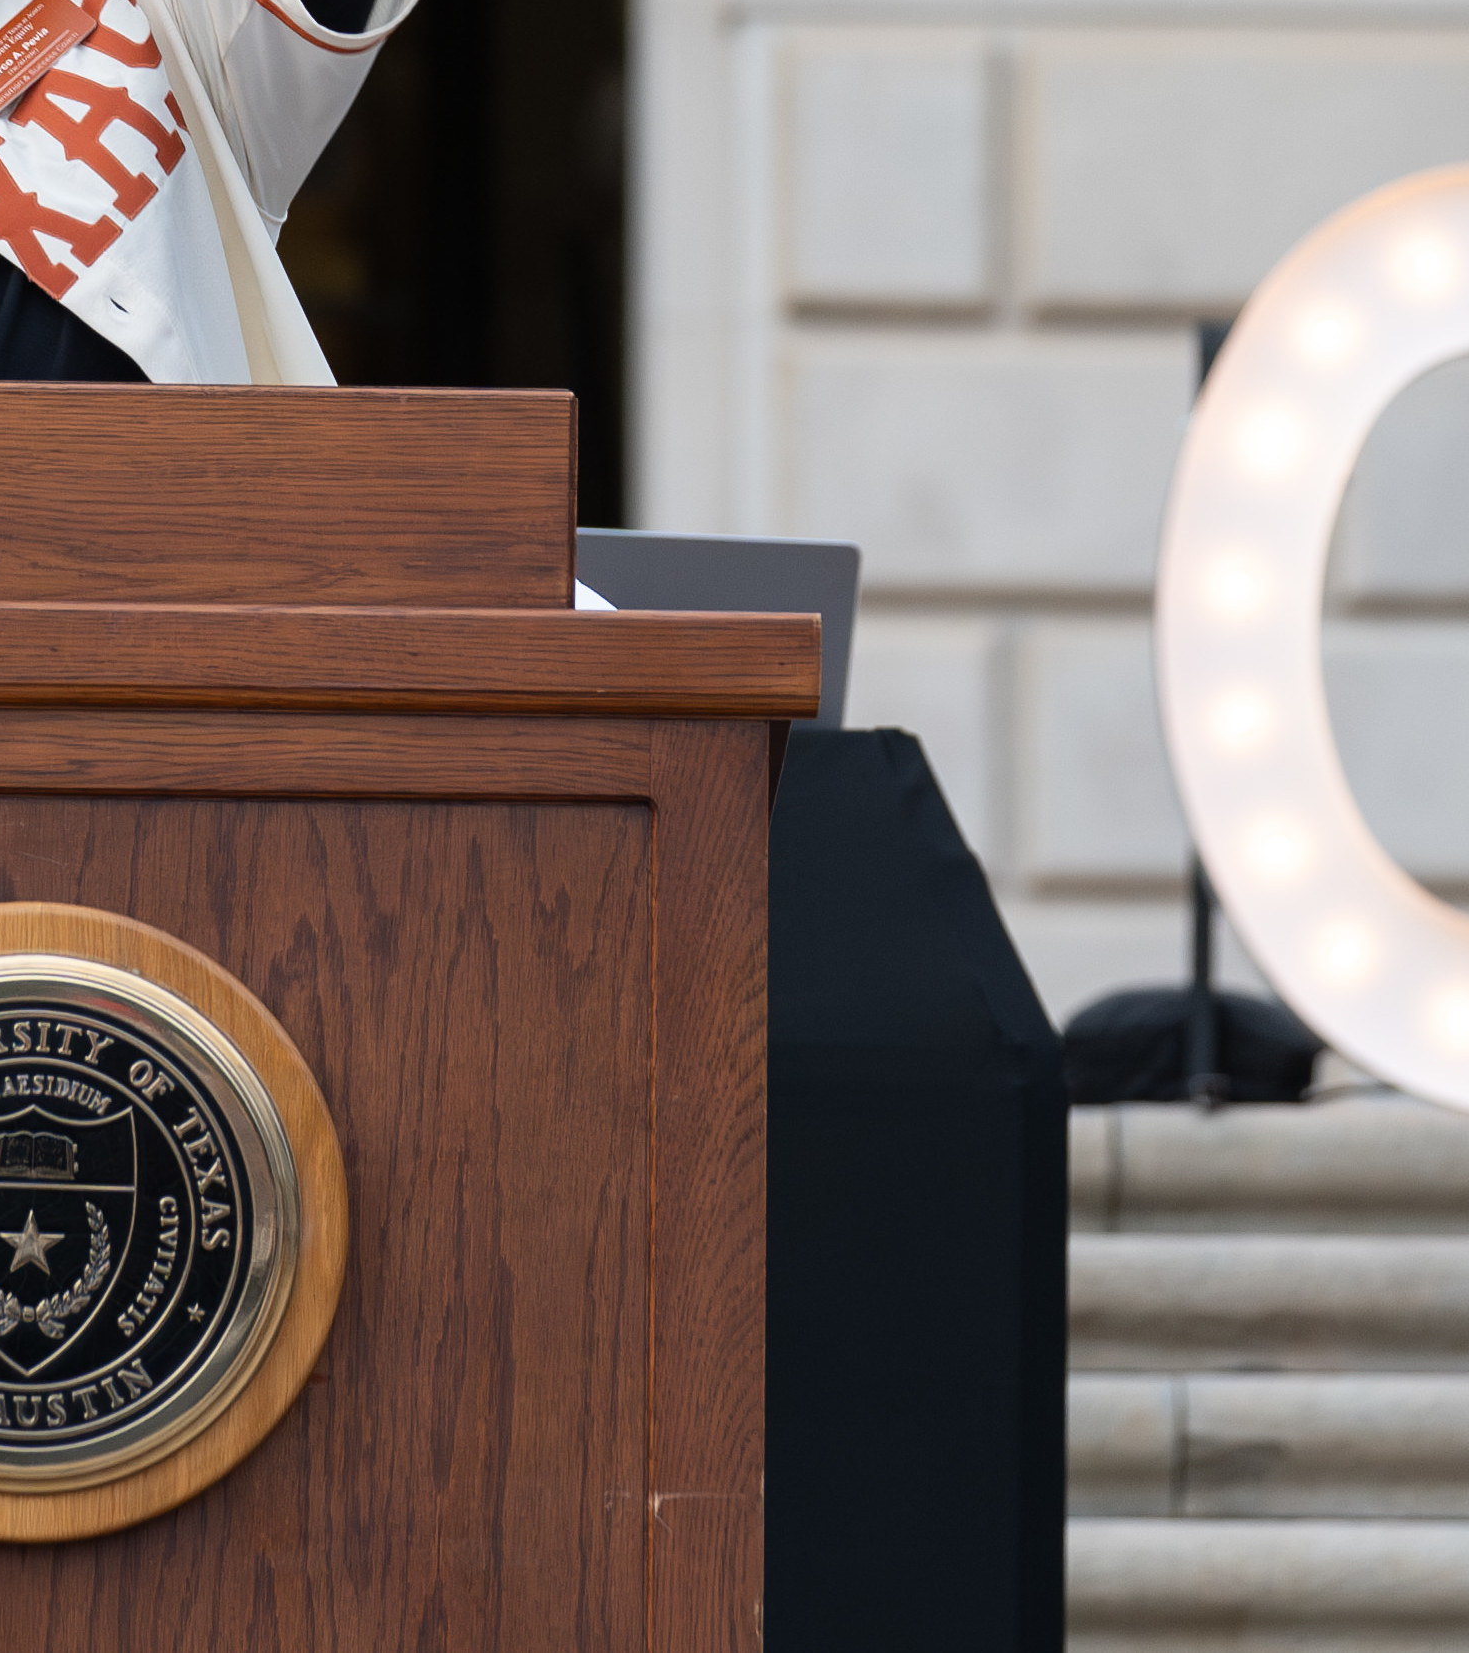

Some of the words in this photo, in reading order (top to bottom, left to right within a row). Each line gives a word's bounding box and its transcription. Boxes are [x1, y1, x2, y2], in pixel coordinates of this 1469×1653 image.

[8, 21, 35, 47] Equity
[12, 48, 25, 61] A.
[21, 26, 49, 52] Pevia
[28, 48, 59, 76] Success
[56, 30, 80, 53] Coach
[129, 1059, 175, 1101] OF
[173, 1106, 231, 1251] TEXAS
[117, 1196, 179, 1337] CIVITATIS
